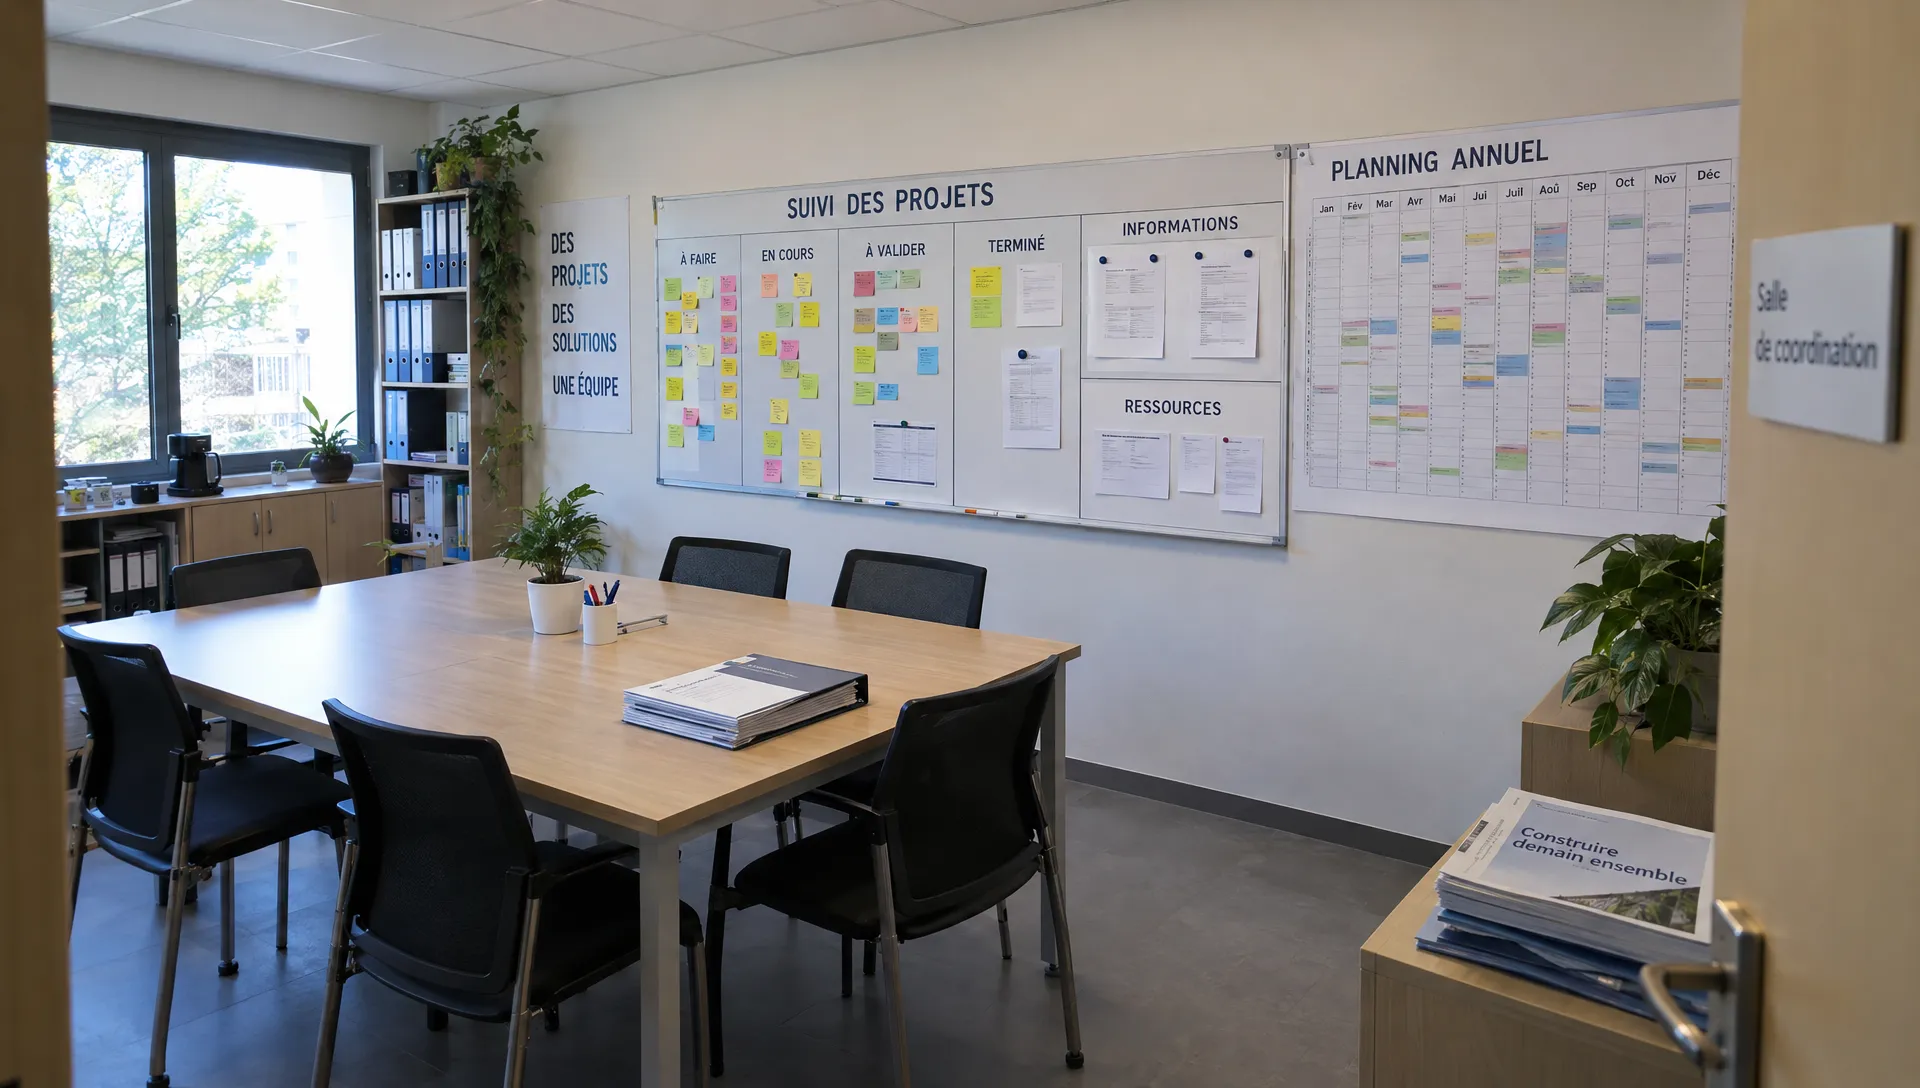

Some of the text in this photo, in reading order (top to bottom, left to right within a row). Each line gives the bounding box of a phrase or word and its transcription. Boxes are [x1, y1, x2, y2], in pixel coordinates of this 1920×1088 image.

[1331, 139, 1548, 181] PLANNING ANNUEL
[787, 182, 994, 219] SUIVI DES PROJETS
[1320, 205, 1334, 213] Jan
[1347, 201, 1363, 211] Fév
[1376, 199, 1393, 208] Mar
[1407, 196, 1423, 206] Avr
[1439, 193, 1456, 203] Mai
[1472, 191, 1487, 200] Jui
[1505, 187, 1523, 198] Juil
[1577, 181, 1597, 192] Sep
[1615, 177, 1635, 188] Oct
[1654, 174, 1677, 184] Nov
[1697, 169, 1721, 180] Déc
[1122, 215, 1239, 236] INFORMATIONS
[551, 231, 574, 254] DES
[865, 242, 926, 258] À VALIDER
[988, 234, 1045, 253] TERMINÉ
[680, 251, 717, 265] À FAIRE
[762, 247, 814, 262] EN COURS
[552, 262, 608, 286] PROJETS
[1757, 279, 1788, 312] Salle
[552, 303, 574, 324] DES
[552, 332, 617, 353] SOLUTIONS
[1755, 329, 1878, 369] de coordination
[553, 371, 619, 397] UNE ÉQUIPE
[1125, 399, 1222, 416] RESSOURCES
[1521, 827, 1619, 857] Construire
[1512, 838, 1584, 863] demain
[1590, 856, 1688, 886] ensemble
